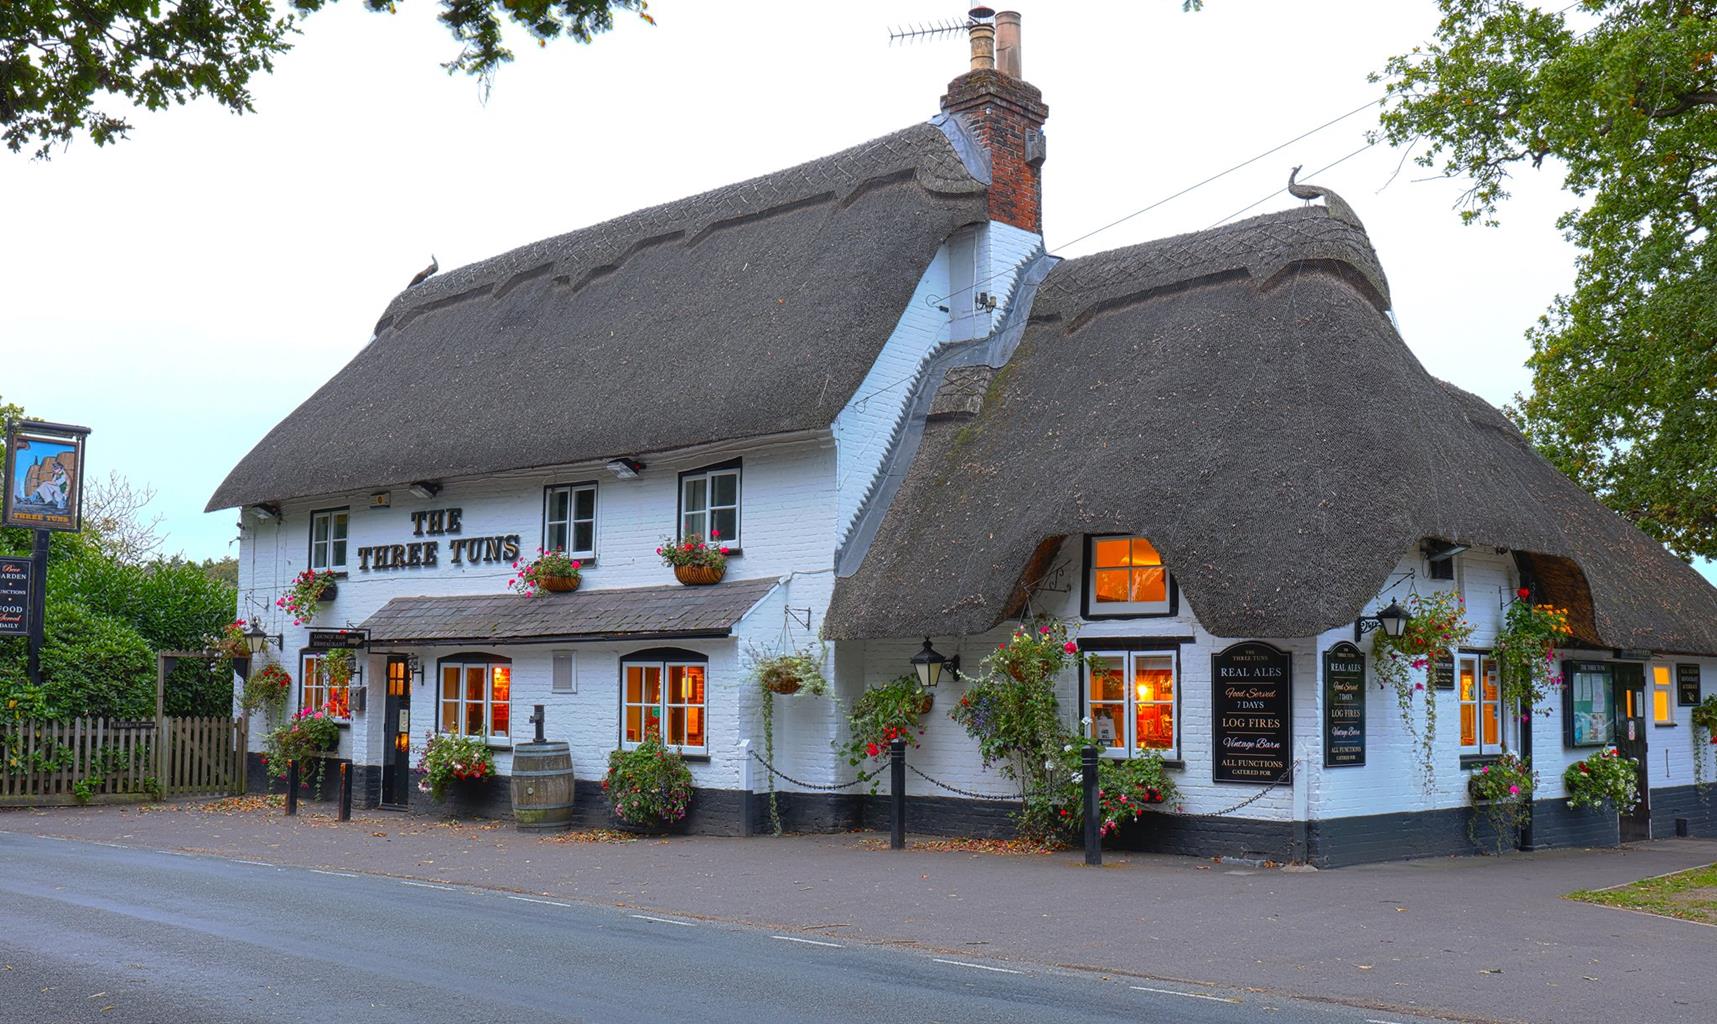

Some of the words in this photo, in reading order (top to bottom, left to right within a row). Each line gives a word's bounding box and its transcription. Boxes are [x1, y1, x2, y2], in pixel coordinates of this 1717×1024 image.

[15, 512, 45, 520] THREE
[411, 508, 463, 535] THE
[358, 541, 439, 570] THREE
[450, 535, 521, 563] TUNS
[1221, 667, 1250, 677] REAL
[1253, 667, 1282, 677] ALES
[1330, 663, 1346, 672] REAL
[1347, 663, 1361, 672] ALES
[1225, 688, 1246, 698] Food
[1246, 687, 1277, 698] Served
[1242, 701, 1265, 709] DAYS
[1331, 709, 1344, 718] LOG
[1344, 710, 1361, 718] FIRES
[1222, 718, 1245, 728] LOG
[1249, 719, 1281, 728] FIRES
[1222, 736, 1255, 750] Vintage
[1255, 737, 1281, 749] Barn
[1221, 759, 1237, 767] ALL
[1238, 760, 1284, 768] FUNCTIONS
